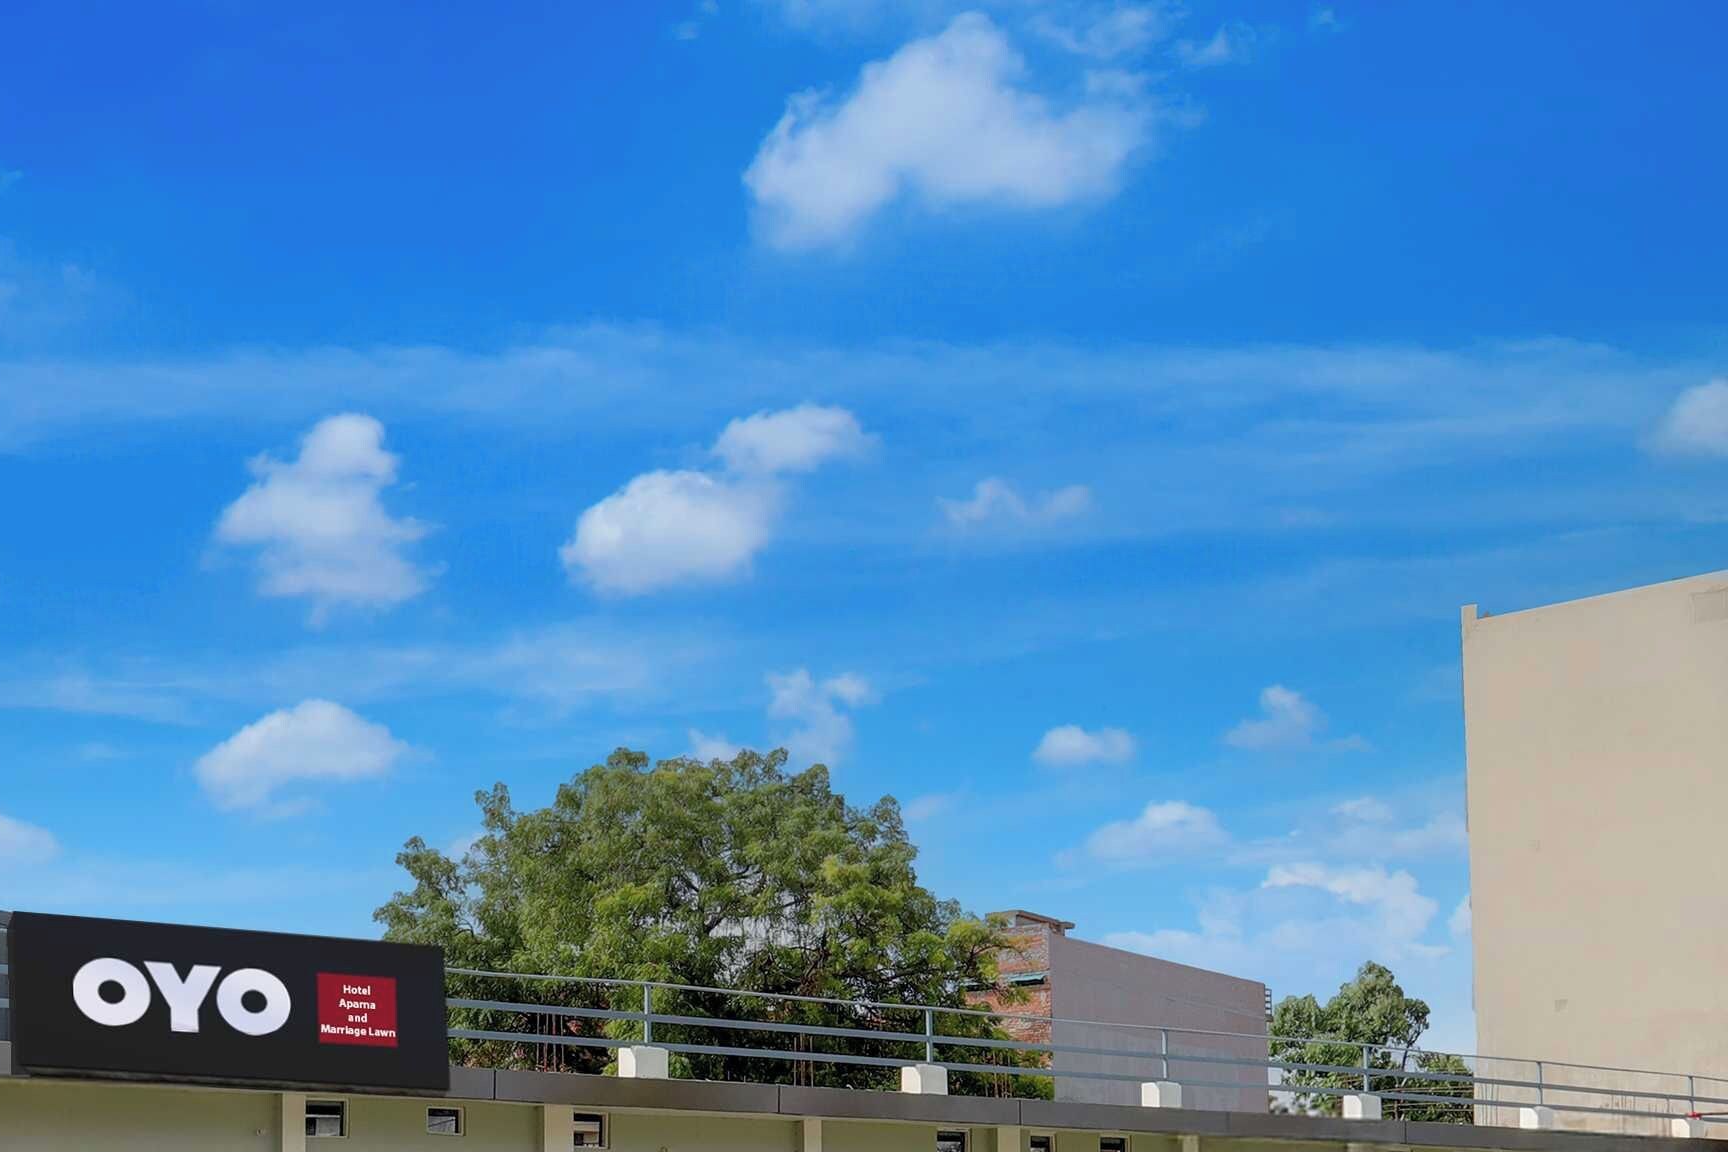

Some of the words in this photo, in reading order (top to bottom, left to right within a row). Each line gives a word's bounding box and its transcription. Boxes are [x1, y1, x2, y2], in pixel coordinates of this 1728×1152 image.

[343, 984, 371, 996] Hotel
[72, 957, 291, 1036] OYO
[338, 998, 376, 1010] Aparna
[348, 1013, 368, 1023] and
[320, 1024, 367, 1037] Marriage
[368, 1027, 396, 1038] Lawn
